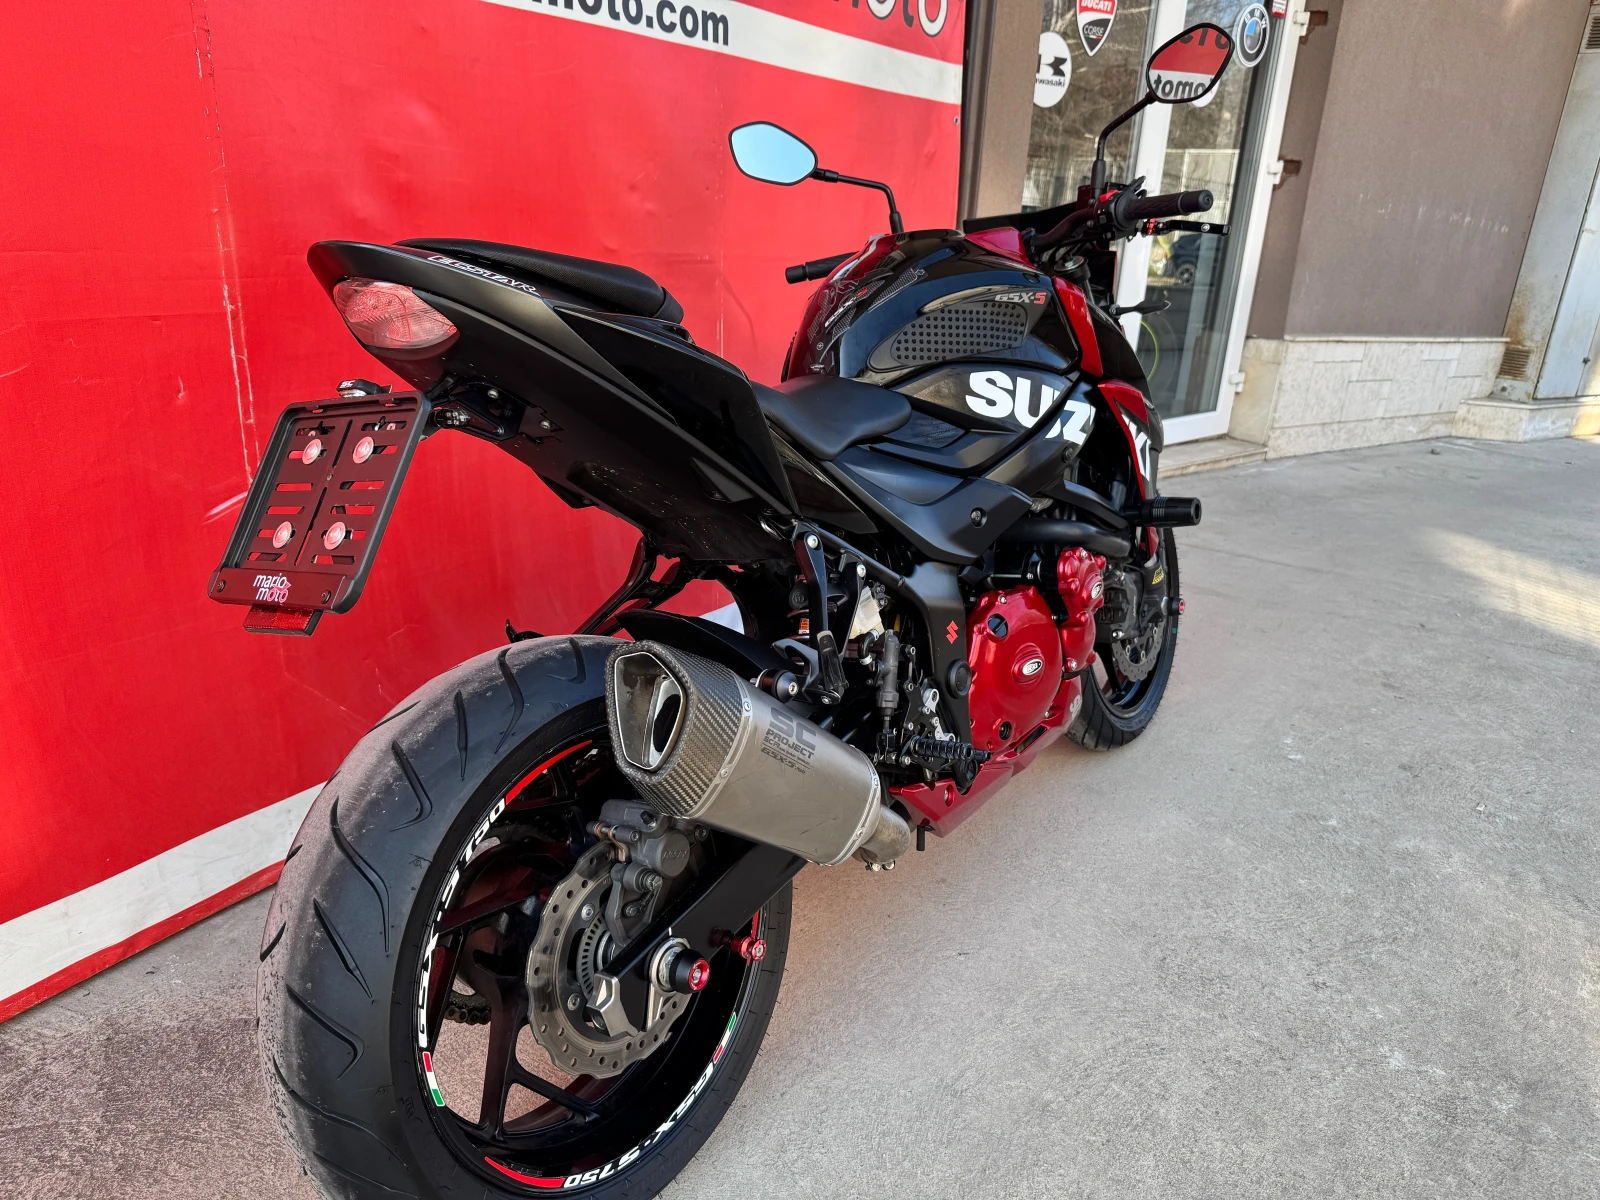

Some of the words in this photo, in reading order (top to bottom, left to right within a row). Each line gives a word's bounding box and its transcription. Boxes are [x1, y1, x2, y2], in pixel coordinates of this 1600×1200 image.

[1081, 0, 1113, 12] DUCATI
[531, 0, 730, 46] o.com
[1244, 8, 1267, 29] BMW
[1035, 78, 1066, 88] wasaki
[994, 291, 1047, 305] GSX-S
[252, 572, 288, 588] mario
[769, 706, 817, 752] SC
[765, 727, 815, 759] PROJECT
